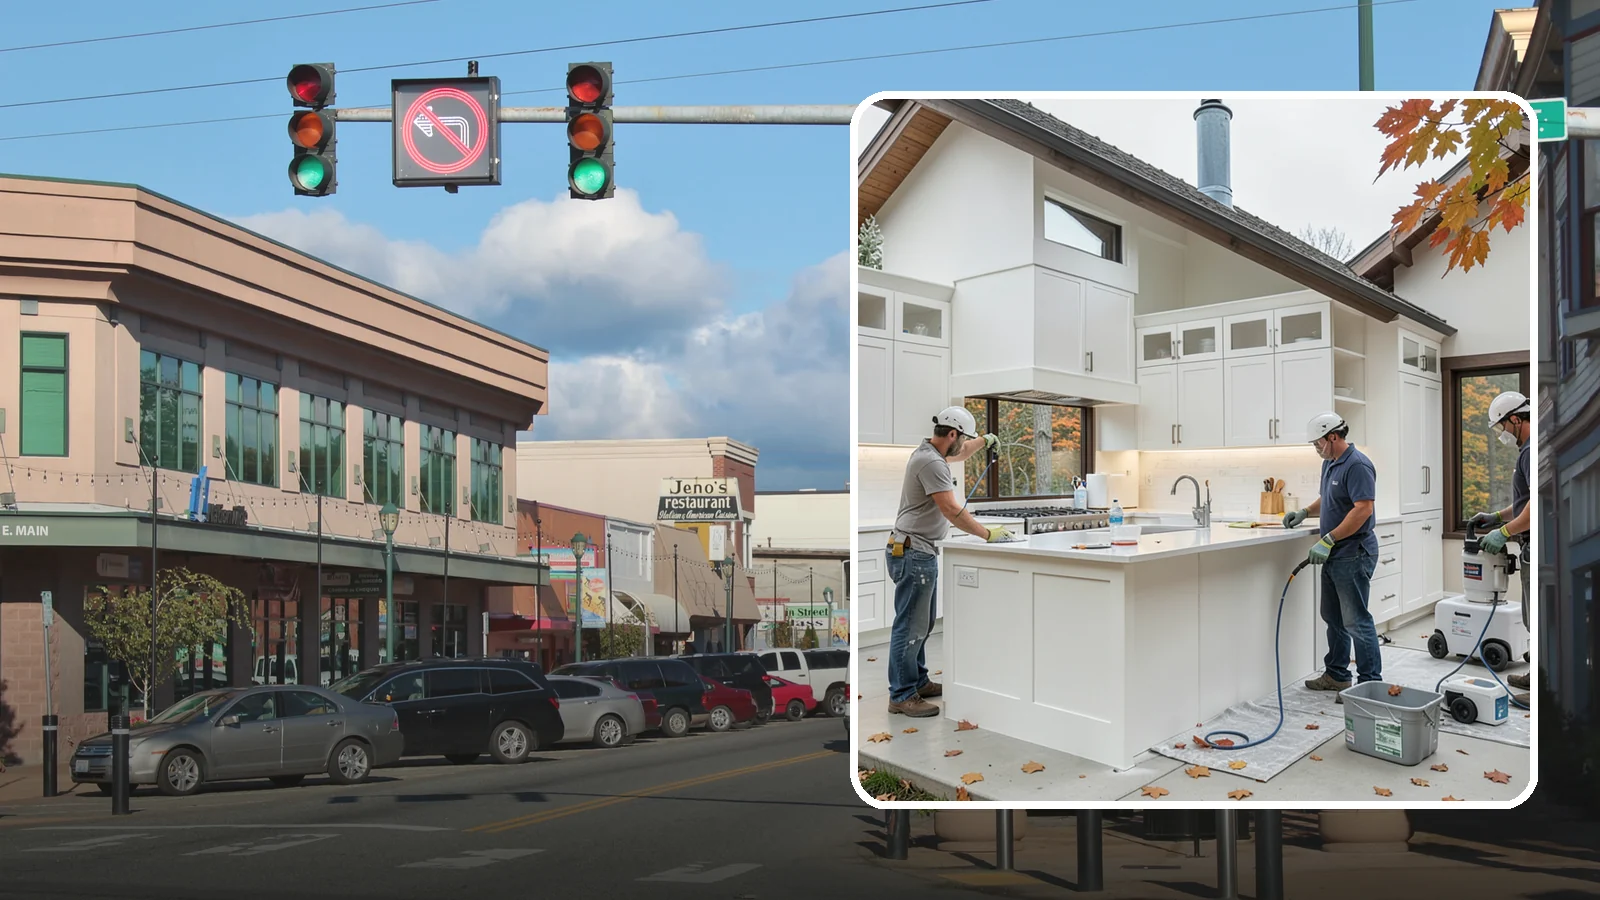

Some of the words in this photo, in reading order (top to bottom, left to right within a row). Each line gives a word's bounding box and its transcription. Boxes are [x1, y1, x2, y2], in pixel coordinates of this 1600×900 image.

[670, 480, 727, 494] Jeno's
[665, 496, 731, 509] restaurant
[658, 510, 681, 520] Italian
[686, 509, 714, 519] American
[715, 509, 737, 519] Cuisine
[2, 525, 13, 536] E.
[15, 525, 49, 537] MAIN
[797, 607, 828, 617] Street
